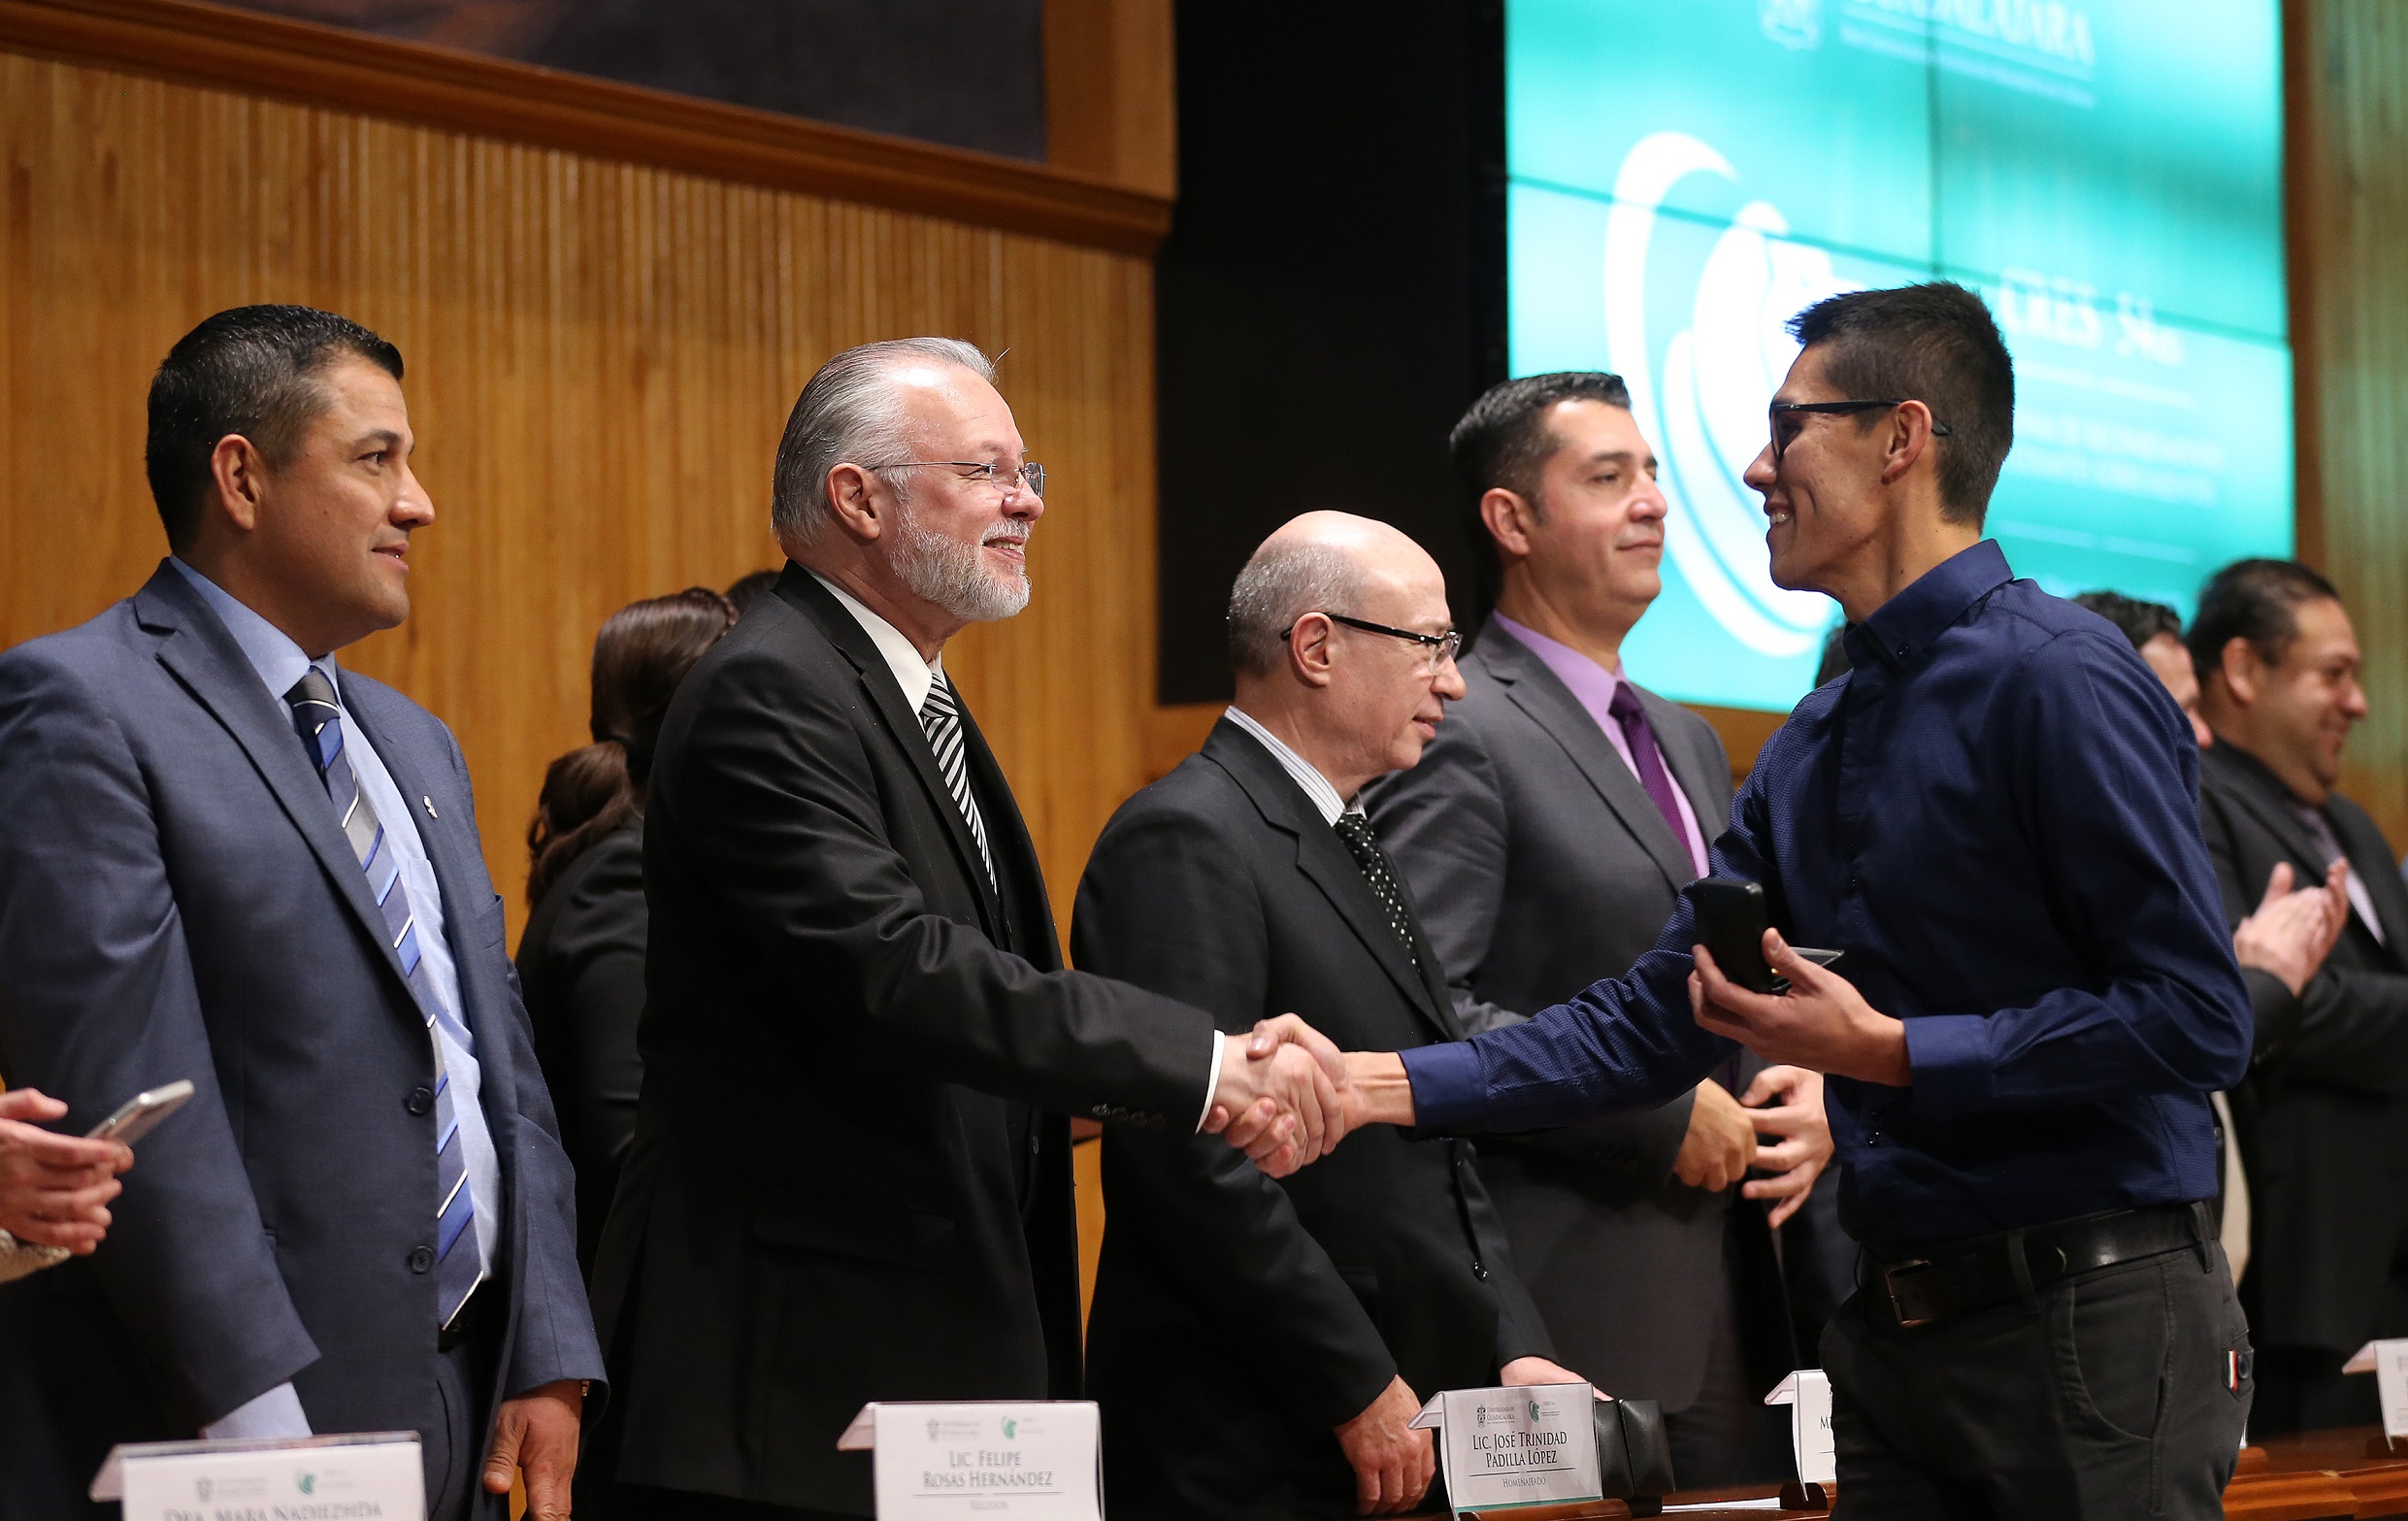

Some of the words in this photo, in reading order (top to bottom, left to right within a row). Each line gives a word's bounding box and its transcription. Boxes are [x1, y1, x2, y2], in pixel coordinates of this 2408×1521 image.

[1472, 1435, 1492, 1450] LIC.
[1494, 1431, 1515, 1452] JOSÉ
[1518, 1431, 1567, 1447] TRINIDAD
[978, 1450, 1021, 1467] FELIPE
[1486, 1452, 1526, 1468] PADILLA
[1528, 1447, 1558, 1466] LÓPEZ
[923, 1471, 966, 1488] ROSAS
[970, 1467, 1053, 1487] HERNÁNDEZ
[1502, 1477, 1546, 1487] HOMENAJEADO
